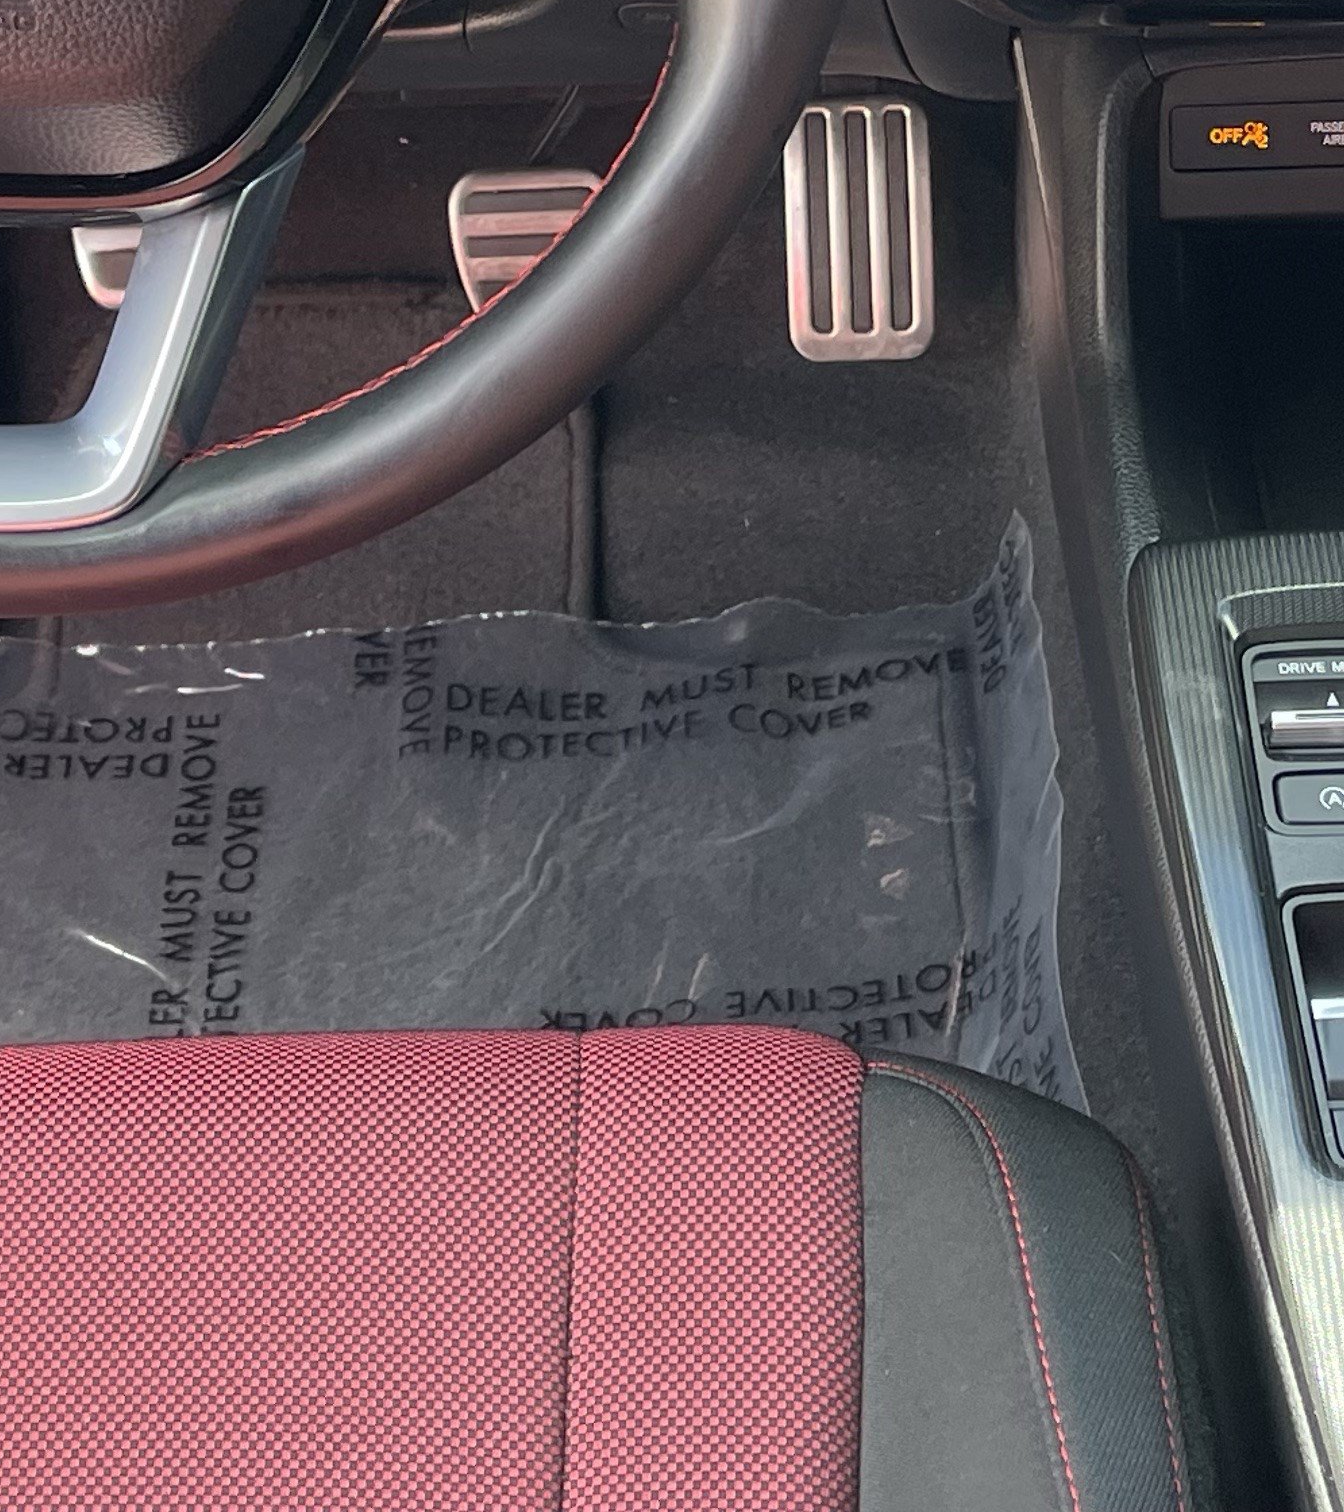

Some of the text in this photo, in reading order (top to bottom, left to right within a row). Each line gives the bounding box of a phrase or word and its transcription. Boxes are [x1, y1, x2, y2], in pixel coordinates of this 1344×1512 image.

[1209, 128, 1243, 144] OFF
[445, 648, 968, 722] DEALER MUST REMOVE
[1278, 661, 1326, 675] DRIVE
[444, 701, 873, 762] PROTECTIVE COVER
[3, 751, 170, 781] DEALER
[172, 711, 223, 848] REMOVE
[220, 785, 265, 896] COVER
[160, 870, 203, 963] MUST
